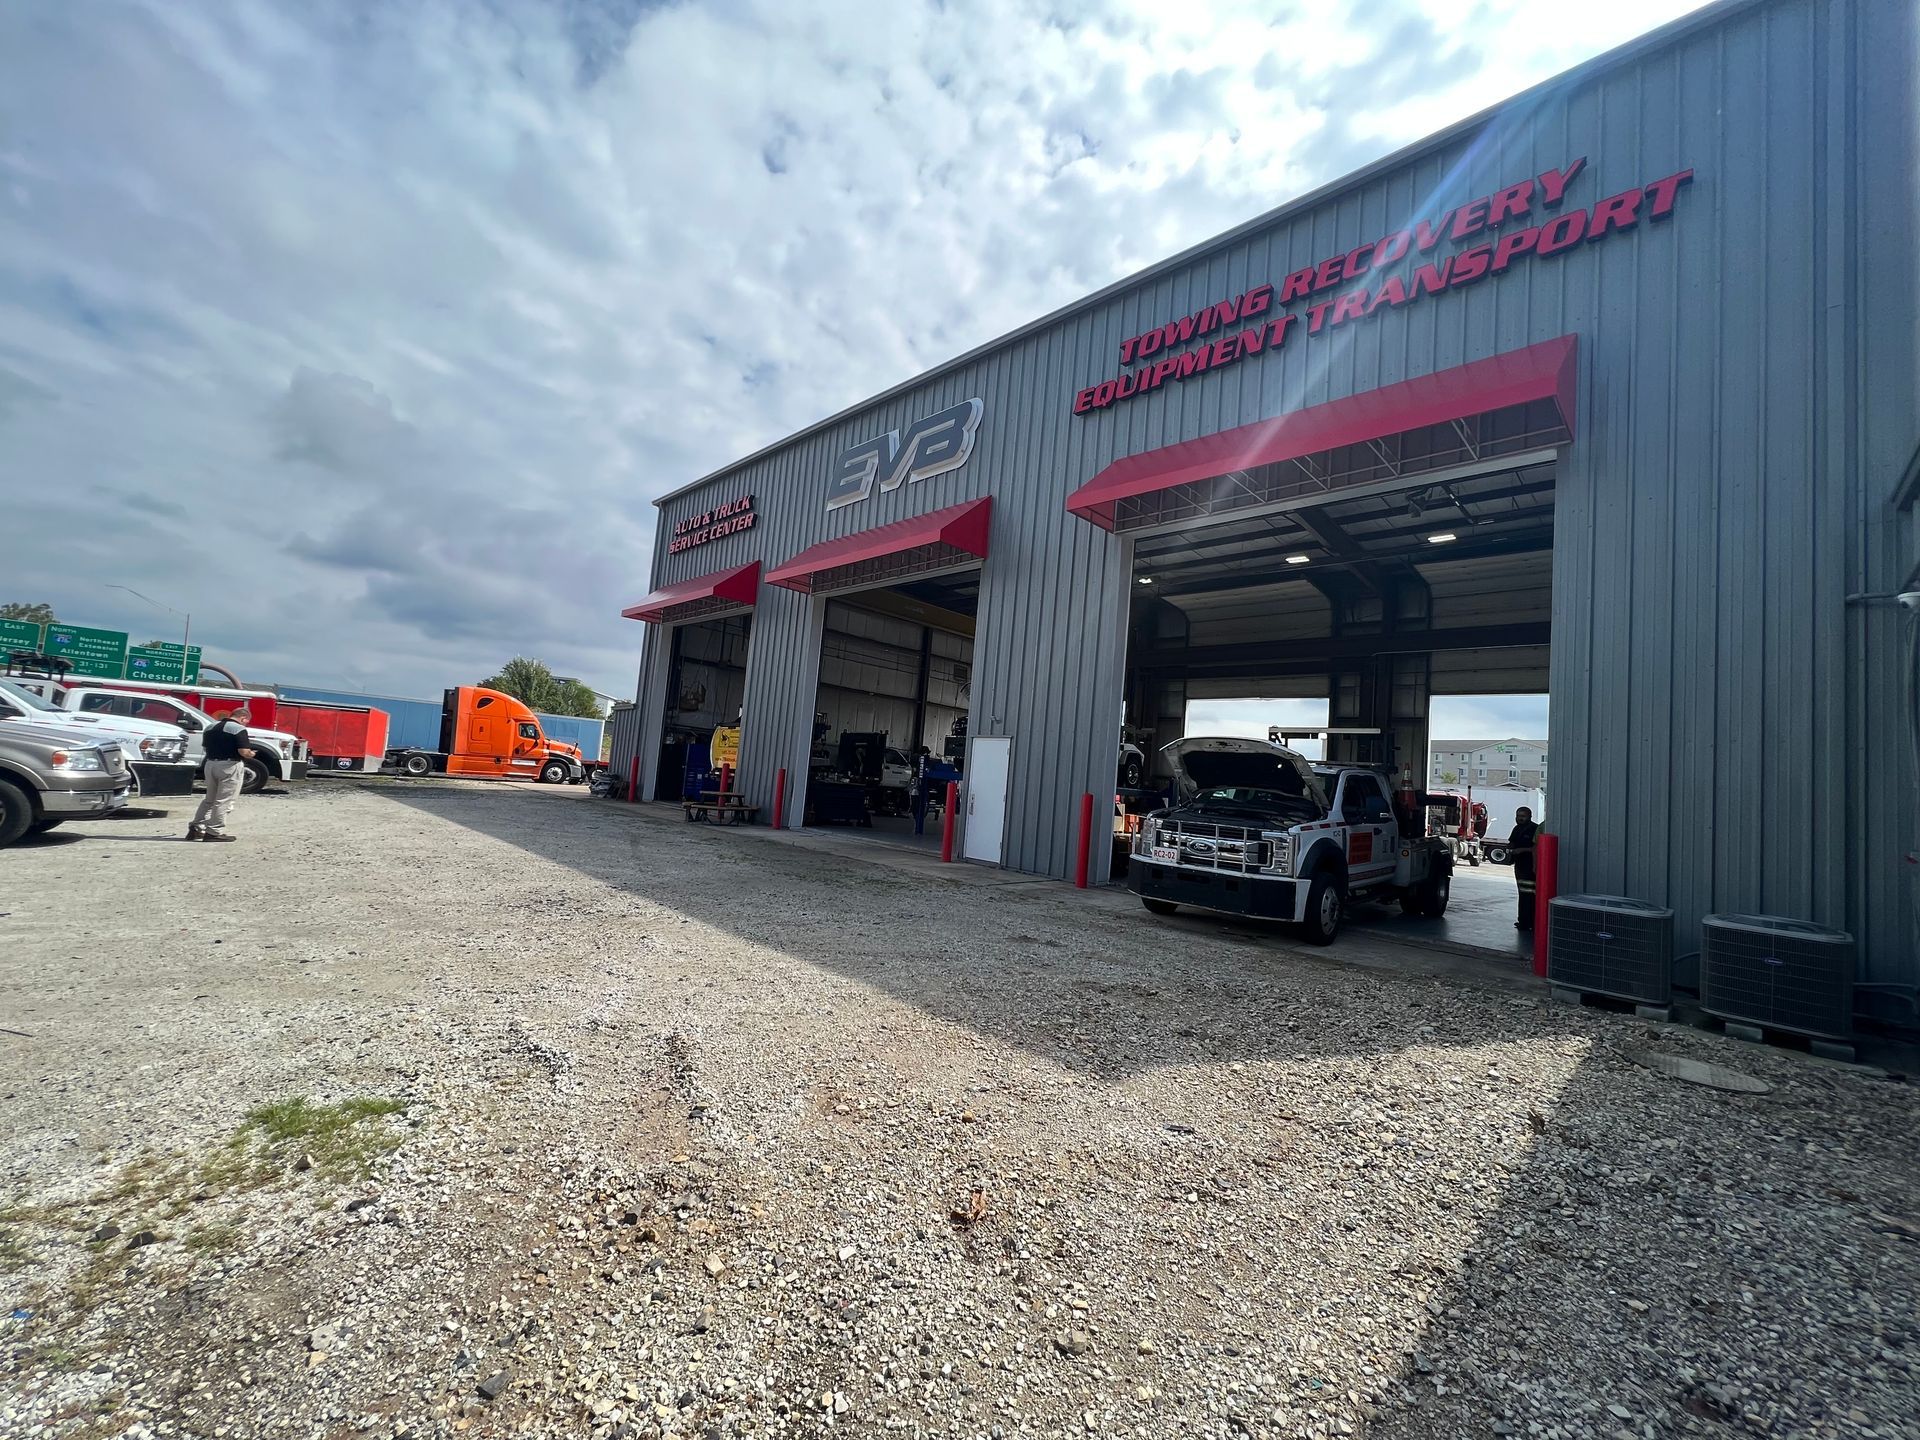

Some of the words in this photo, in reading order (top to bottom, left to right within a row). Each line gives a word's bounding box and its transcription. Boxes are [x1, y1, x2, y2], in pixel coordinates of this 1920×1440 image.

[1119, 284, 1274, 366] TOWING
[1279, 156, 1587, 307] RECOVERY
[1073, 314, 1298, 417] EQUIPMENT
[1306, 168, 1694, 337] TRANSPORT
[826, 397, 985, 512] EVB
[674, 514, 702, 536] AUTO
[702, 511, 711, 526] &
[713, 495, 755, 520] TRUCK
[668, 529, 709, 554] SERVICE
[709, 512, 757, 540] CENTER
[4, 623, 26, 631] EAST
[50, 626, 77, 635] NORTH
[79, 636, 119, 646] Northeast
[78, 642, 119, 652] Extension
[60, 647, 109, 659] Allentown
[153, 660, 184, 669] SOUTH
[132, 671, 179, 682] Chester
